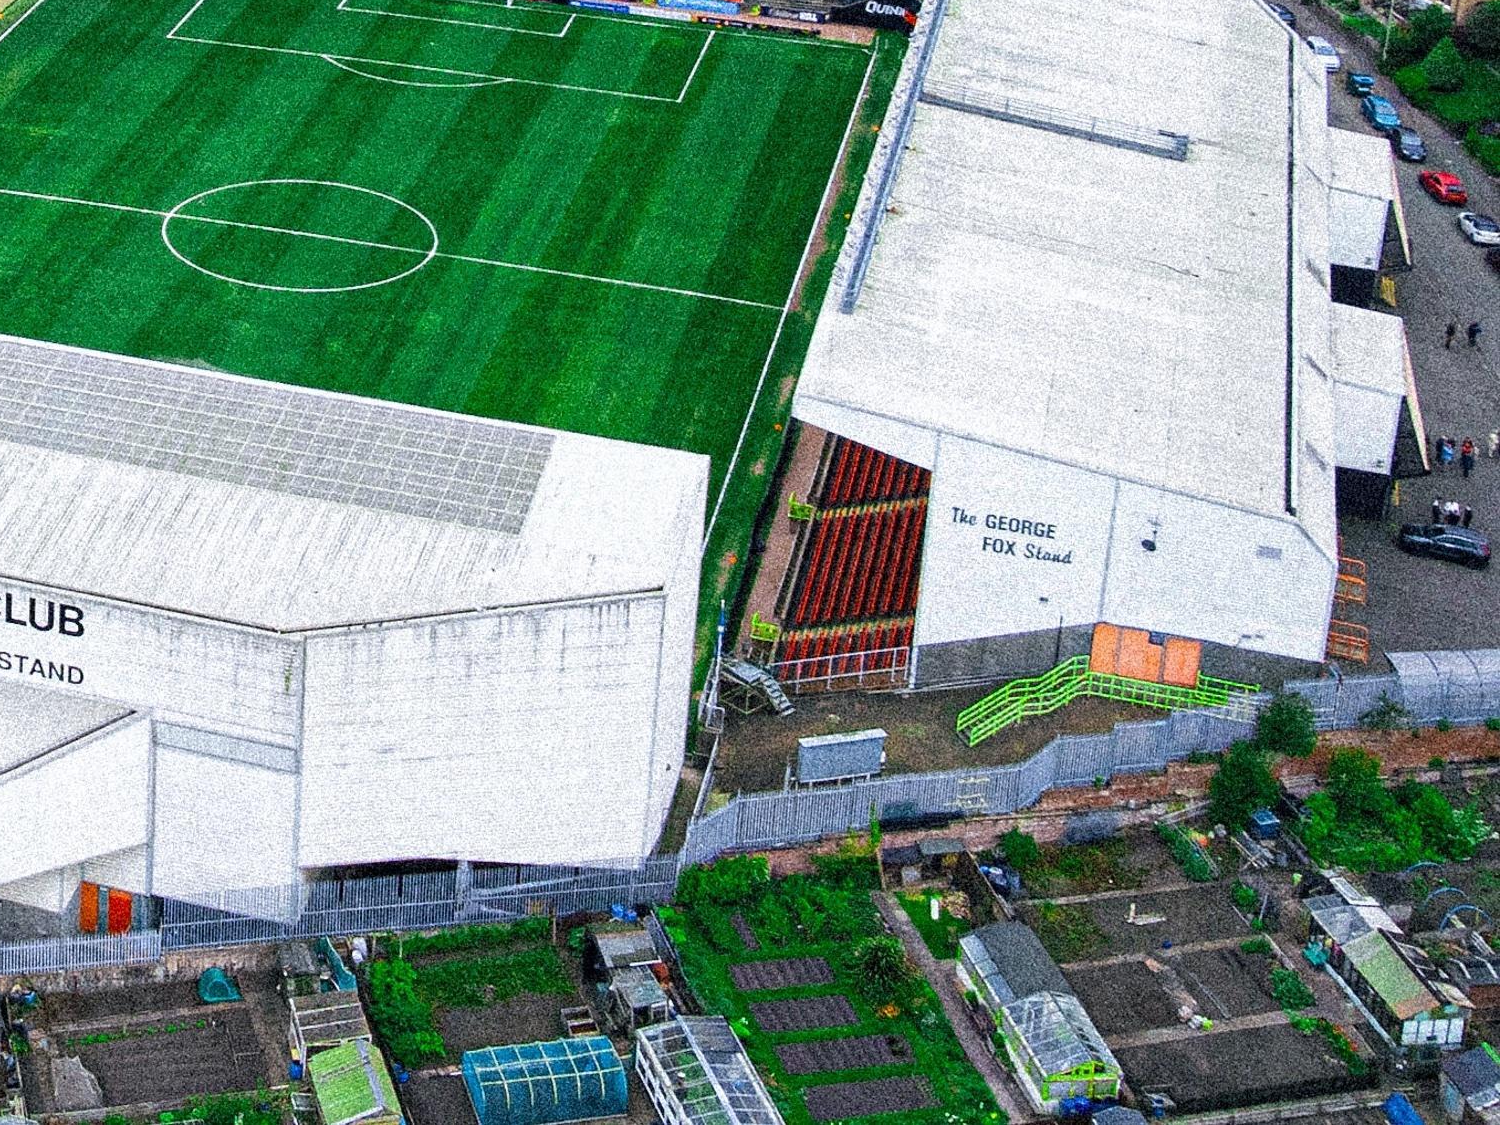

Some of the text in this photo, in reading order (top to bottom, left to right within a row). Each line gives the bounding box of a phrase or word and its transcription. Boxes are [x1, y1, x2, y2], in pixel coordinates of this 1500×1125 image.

[952, 507, 1057, 539] The GEORGE
[982, 536, 1072, 564] FOX Stand
